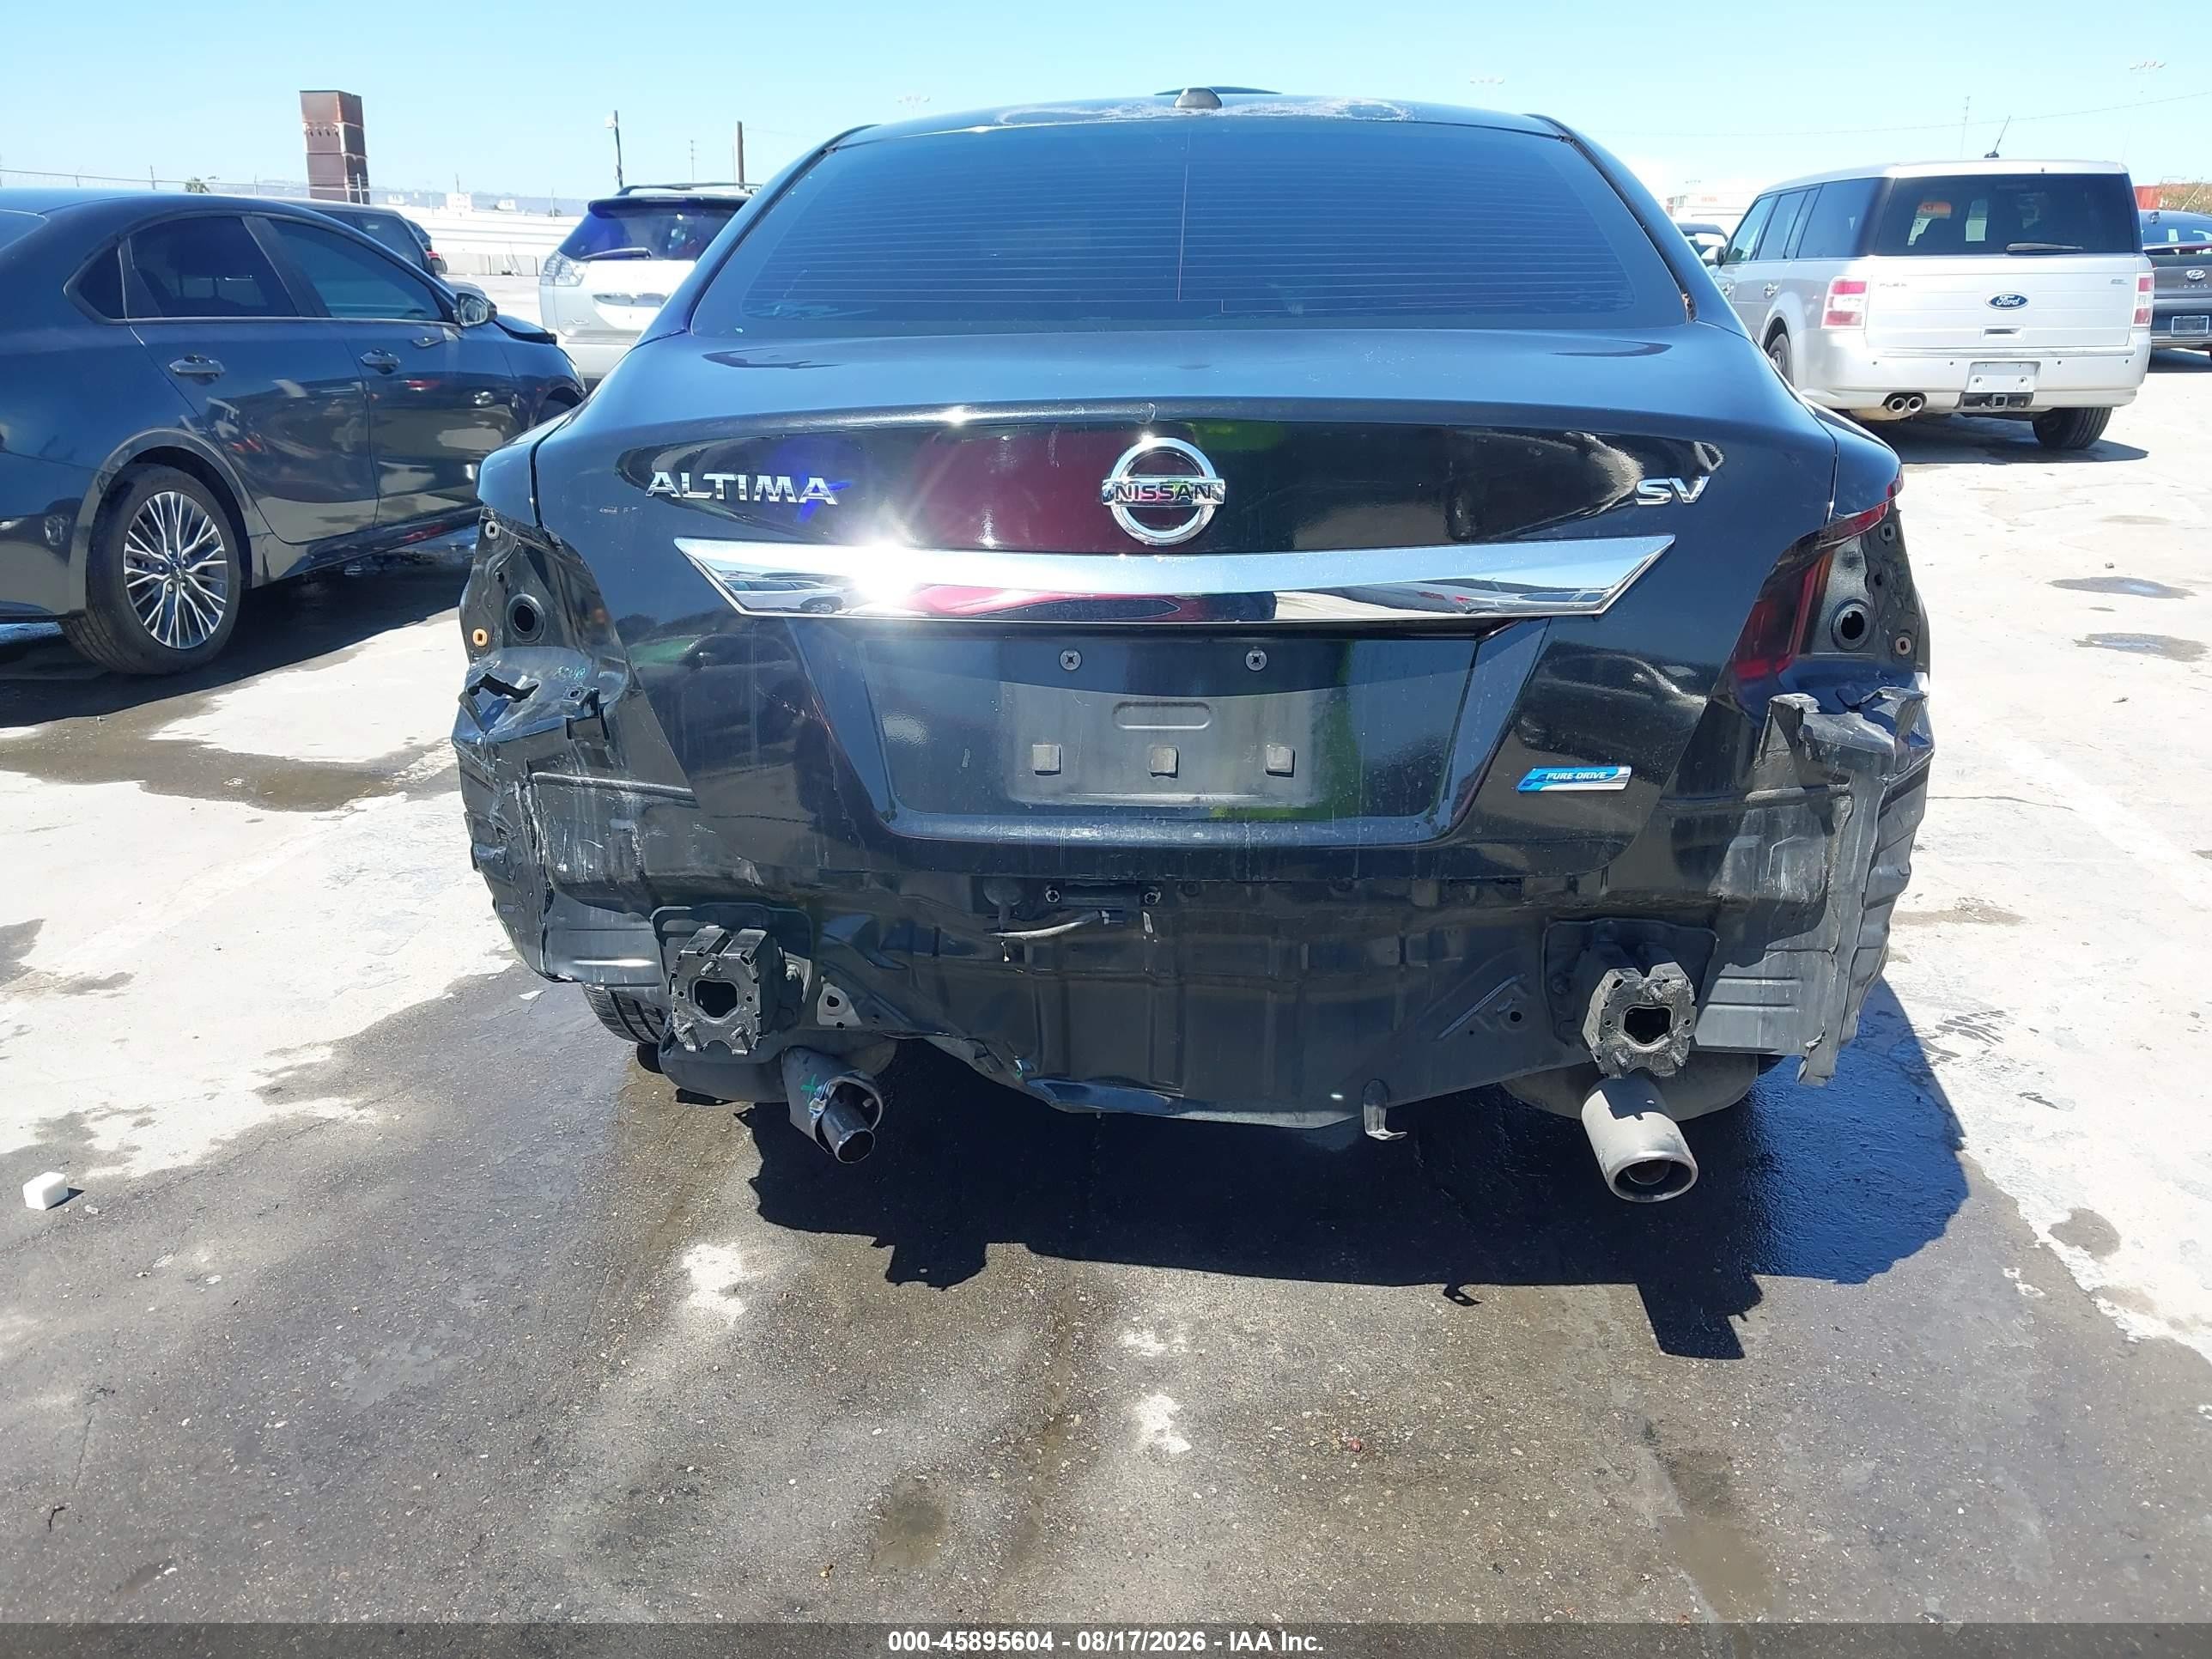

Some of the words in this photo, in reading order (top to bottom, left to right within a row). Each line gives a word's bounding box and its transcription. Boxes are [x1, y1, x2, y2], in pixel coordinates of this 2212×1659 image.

[1996, 295, 2021, 306] Ford
[646, 471, 838, 505] ALTIMA
[1114, 484, 1212, 501] NISSAN
[1635, 476, 1711, 505] SV
